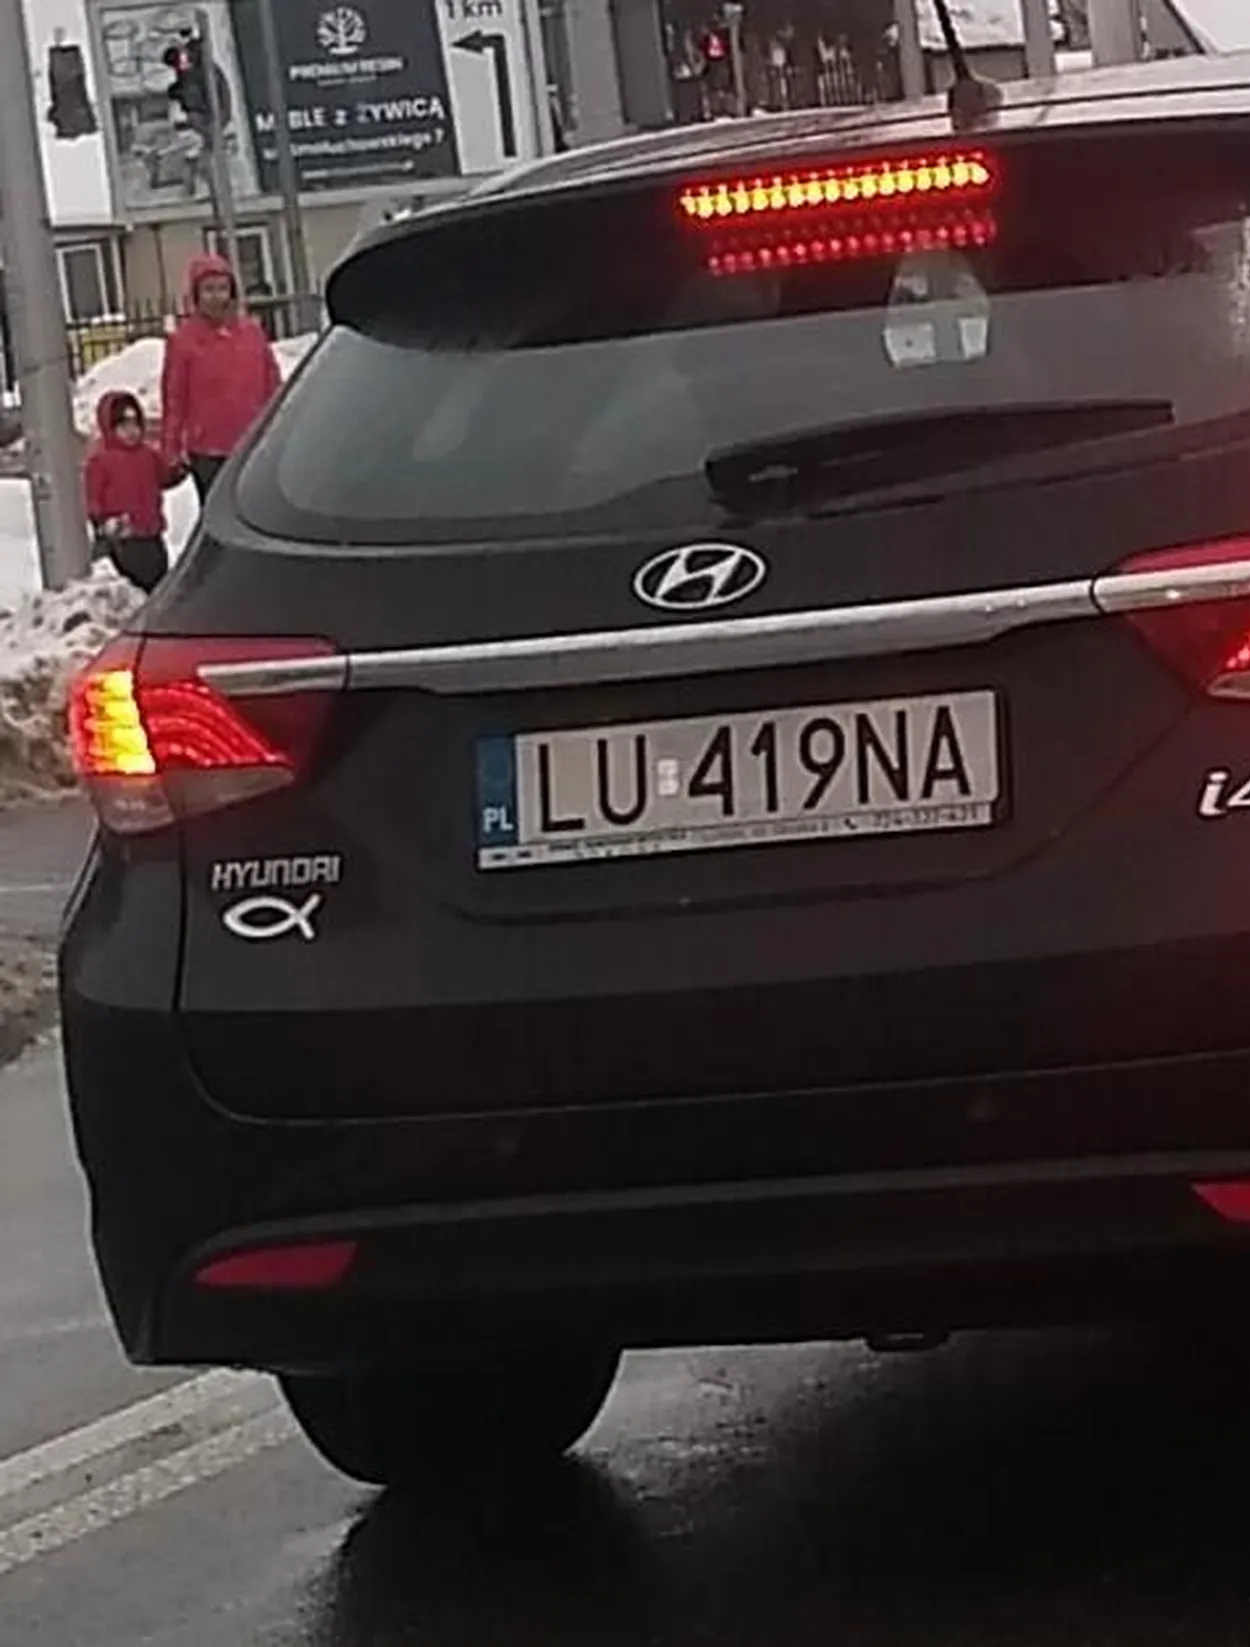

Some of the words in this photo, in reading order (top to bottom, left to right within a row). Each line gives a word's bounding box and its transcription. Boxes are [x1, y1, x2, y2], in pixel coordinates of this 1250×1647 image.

[461, 0, 503, 18] km
[256, 107, 327, 131] MBLE
[538, 734, 647, 833] LU
[687, 705, 973, 818] 419NA
[483, 805, 514, 833] PL
[211, 855, 341, 891] HYUNDAI
